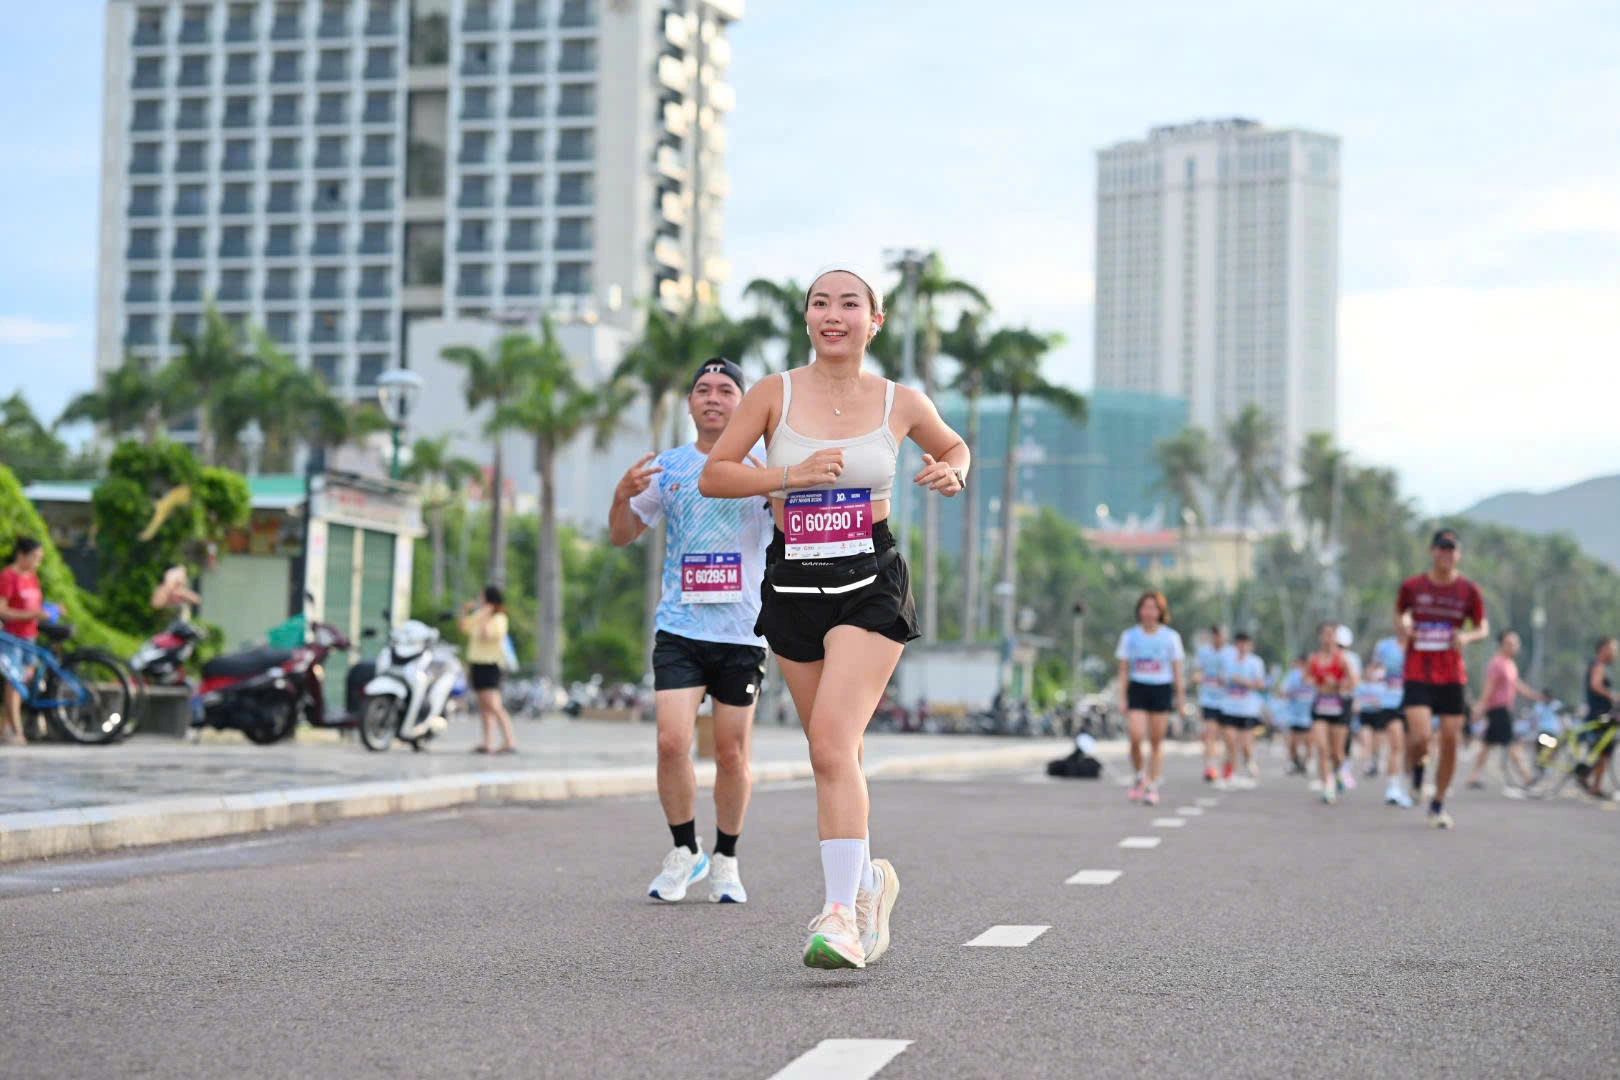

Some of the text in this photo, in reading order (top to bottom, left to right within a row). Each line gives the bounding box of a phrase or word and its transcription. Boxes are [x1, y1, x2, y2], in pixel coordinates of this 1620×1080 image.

[791, 510, 863, 532] C 60290 F
[685, 569, 738, 584] C 60295 M
